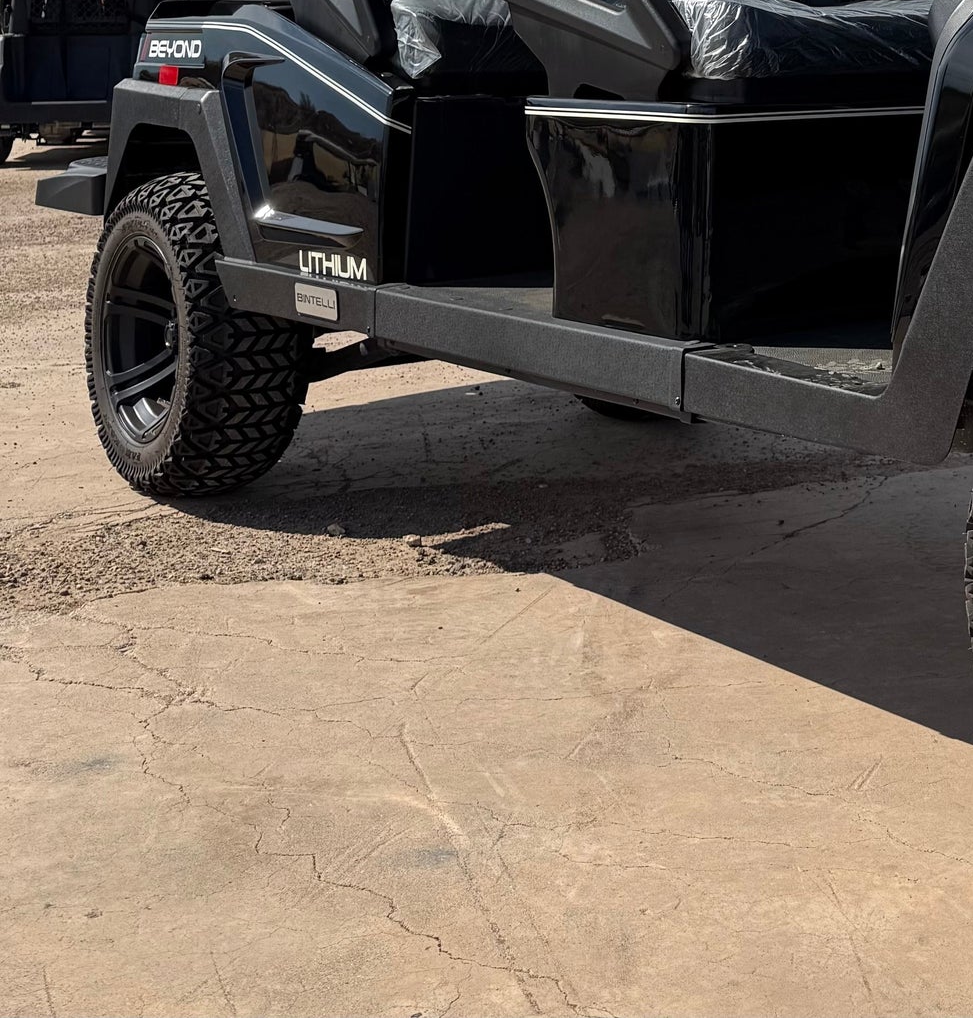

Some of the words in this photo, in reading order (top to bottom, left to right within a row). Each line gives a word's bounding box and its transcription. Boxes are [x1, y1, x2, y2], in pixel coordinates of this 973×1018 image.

[148, 39, 202, 58] BEYOND
[298, 249, 367, 281] LITHIUM
[296, 292, 336, 310] BINTELLI
